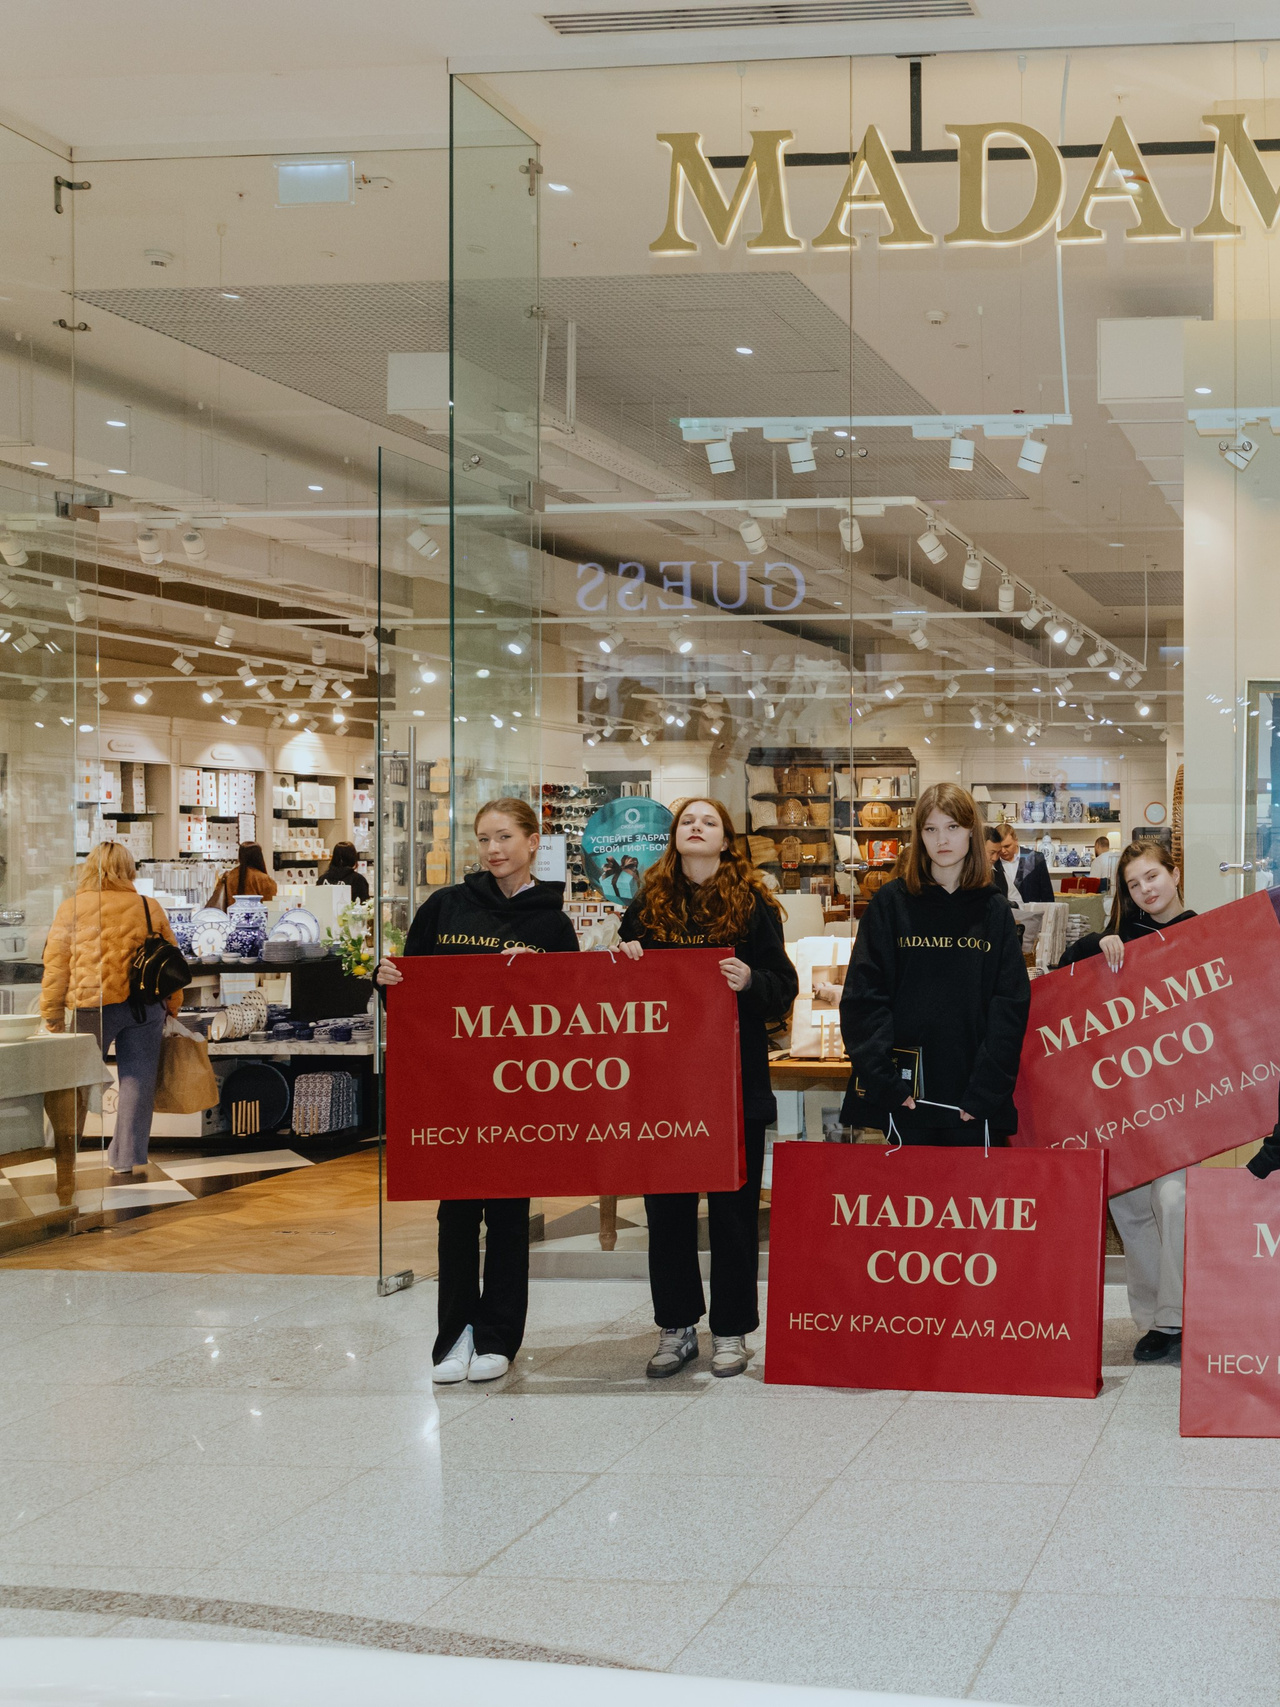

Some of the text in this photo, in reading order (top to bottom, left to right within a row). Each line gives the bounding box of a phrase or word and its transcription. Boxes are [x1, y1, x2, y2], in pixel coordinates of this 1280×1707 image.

[590, 833, 670, 844] УСПЕЙТЕ ЗАБРАТ
[593, 843, 620, 853] СВОЙ
[436, 934, 500, 948] MADAME
[452, 1001, 669, 1038] MADAME
[1035, 957, 1233, 1058] MADAME
[1092, 1022, 1214, 1090] COCO
[493, 1058, 630, 1092] COCO
[1095, 1094, 1184, 1142] КРАСОТУ
[1195, 1077, 1233, 1108] ДЛЯ
[412, 1121, 709, 1145] НЕСУ КРАСОТУ ДЛЯ ДОМА
[831, 1194, 1036, 1230] MADAME
[867, 1250, 997, 1286] COCO
[790, 1313, 1070, 1340] НЕСУ КРАСОТУ ДЛЯ ДОМА
[1208, 1355, 1269, 1374] НЕСУ
